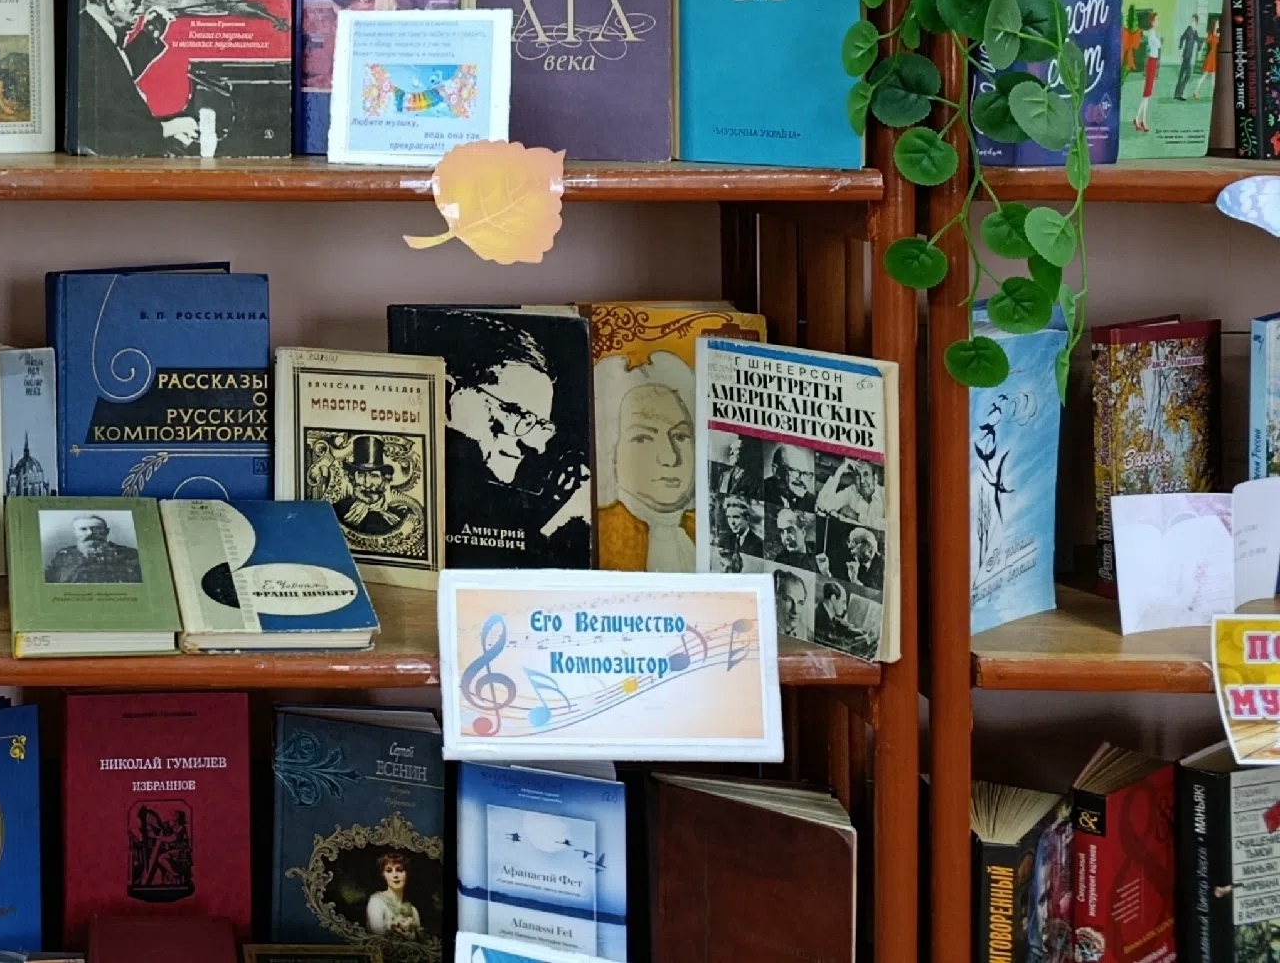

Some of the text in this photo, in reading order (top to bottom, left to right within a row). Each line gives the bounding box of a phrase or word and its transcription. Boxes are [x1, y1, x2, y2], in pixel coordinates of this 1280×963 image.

[1234, 27, 1247, 79] Хоффман
[543, 53, 596, 72] века
[1235, 82, 1245, 109] Элис
[176, 311, 268, 321] РОССИХИНА
[748, 359, 843, 384] ШНЕЕРСОН
[157, 373, 268, 390] РАССКАЗЫ
[308, 381, 421, 394] ВЯЧЕСЛАВ ЛЕБЕДЕВ
[735, 369, 843, 403] ПОРТРЕТЫ
[252, 391, 268, 407] О
[312, 397, 367, 412] МАЭСТРО
[707, 383, 877, 430] АМЕРИКАНСКИХ
[167, 408, 269, 425] РУССКИХ
[371, 409, 420, 424] БОРЬБЫ
[712, 402, 874, 448] КОМПОЗИТОРОВ
[94, 425, 269, 442] КОМПОЗИТОРАХ
[460, 523, 526, 541] Дмитрий
[446, 535, 526, 552] остакович
[530, 610, 685, 633] Его Величество
[550, 651, 669, 679] Композитор
[100, 756, 227, 771] НИКОЛАЙ ГУМИЛЕВ
[376, 760, 428, 782] ЕСЕНИН
[132, 780, 196, 792] ИЗБРАННОЕ
[501, 865, 557, 884] Афанасий
[559, 875, 583, 888] Фет
[986, 865, 1015, 963] ИГОВОРЕННЫЙ
